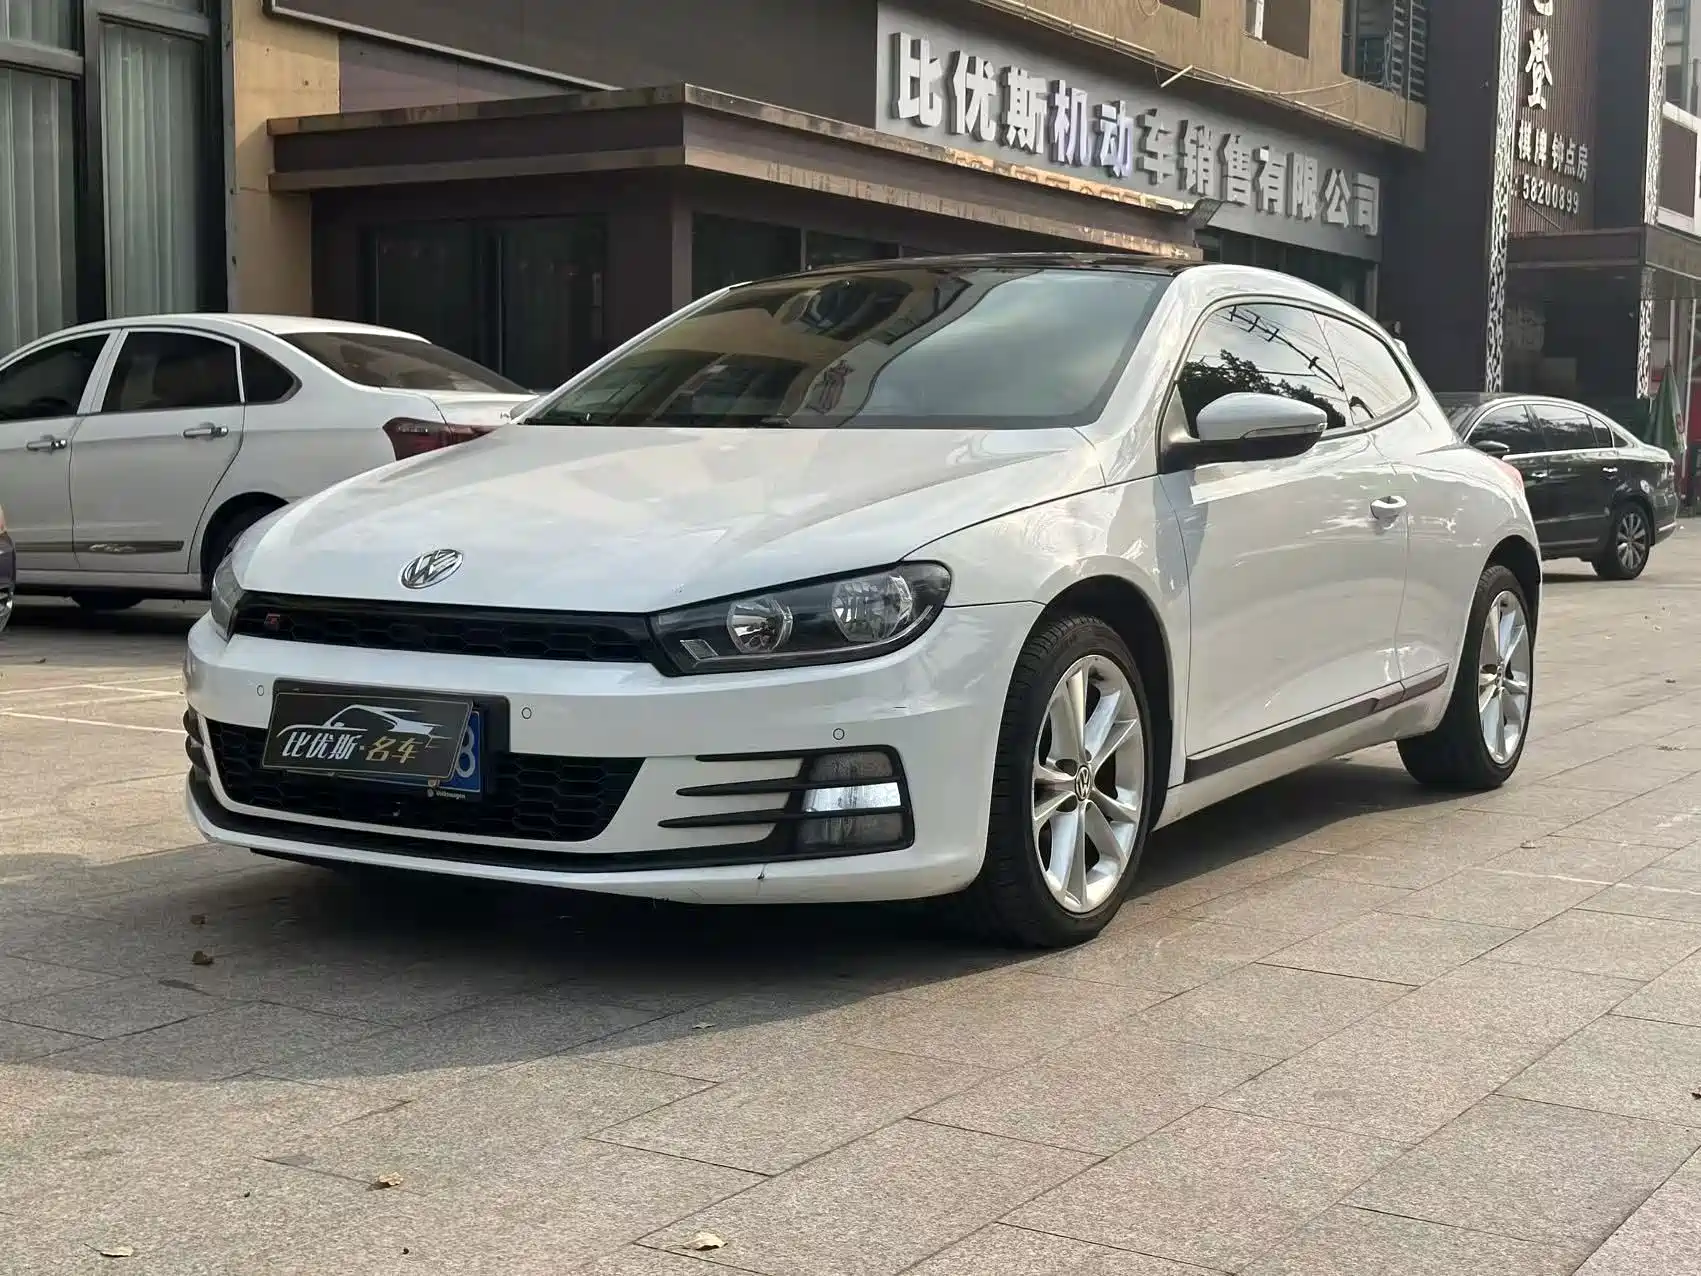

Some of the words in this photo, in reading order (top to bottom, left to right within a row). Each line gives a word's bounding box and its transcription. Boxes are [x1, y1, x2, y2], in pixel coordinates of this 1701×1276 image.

[890, 31, 1381, 237] 比优斯机动车销售有限公司
